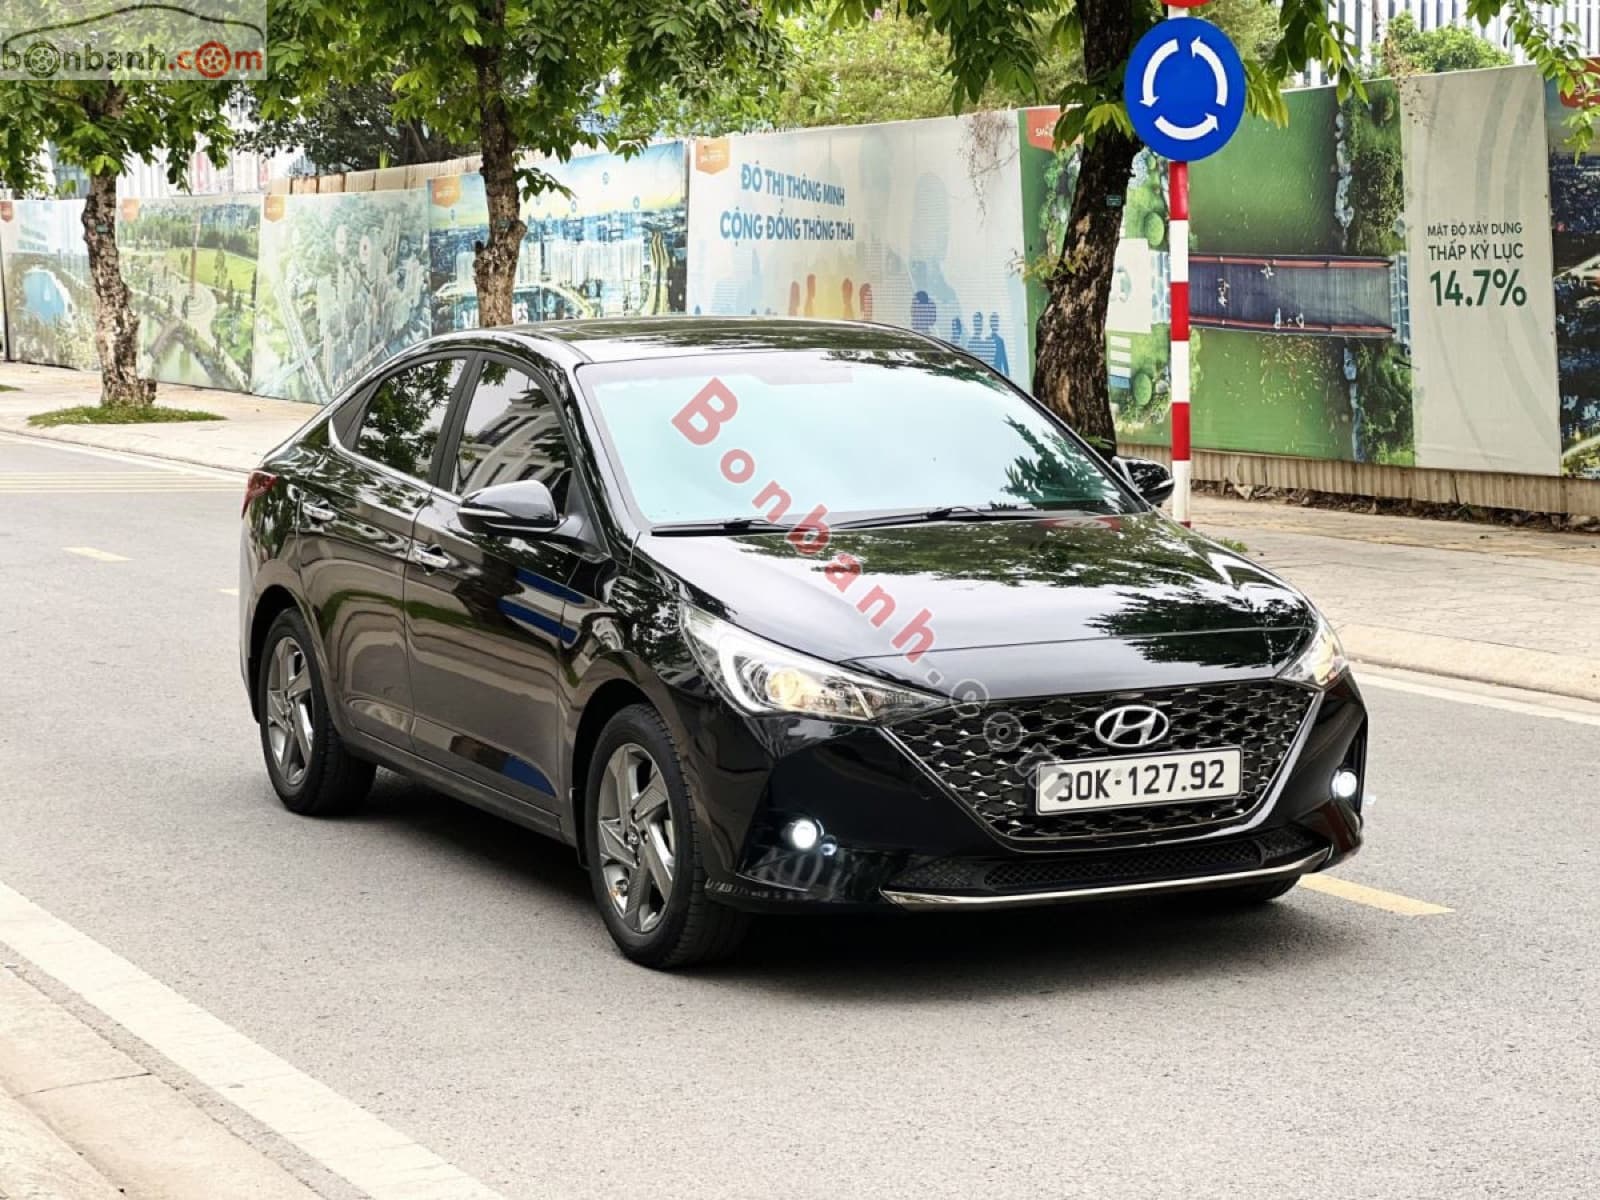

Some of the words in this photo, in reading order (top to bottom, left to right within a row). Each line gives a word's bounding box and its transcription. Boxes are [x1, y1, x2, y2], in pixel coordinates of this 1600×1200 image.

[741, 160, 763, 193] ĐÔ
[765, 169, 785, 203] THỊ
[786, 174, 822, 205] THÔNG
[823, 184, 845, 207] MINH
[720, 206, 763, 246] CỘNG
[802, 215, 834, 241] THÔNG
[1469, 221, 1489, 236] XÂY
[1428, 239, 1467, 261] THẤP
[1430, 268, 1527, 307] 14.7%
